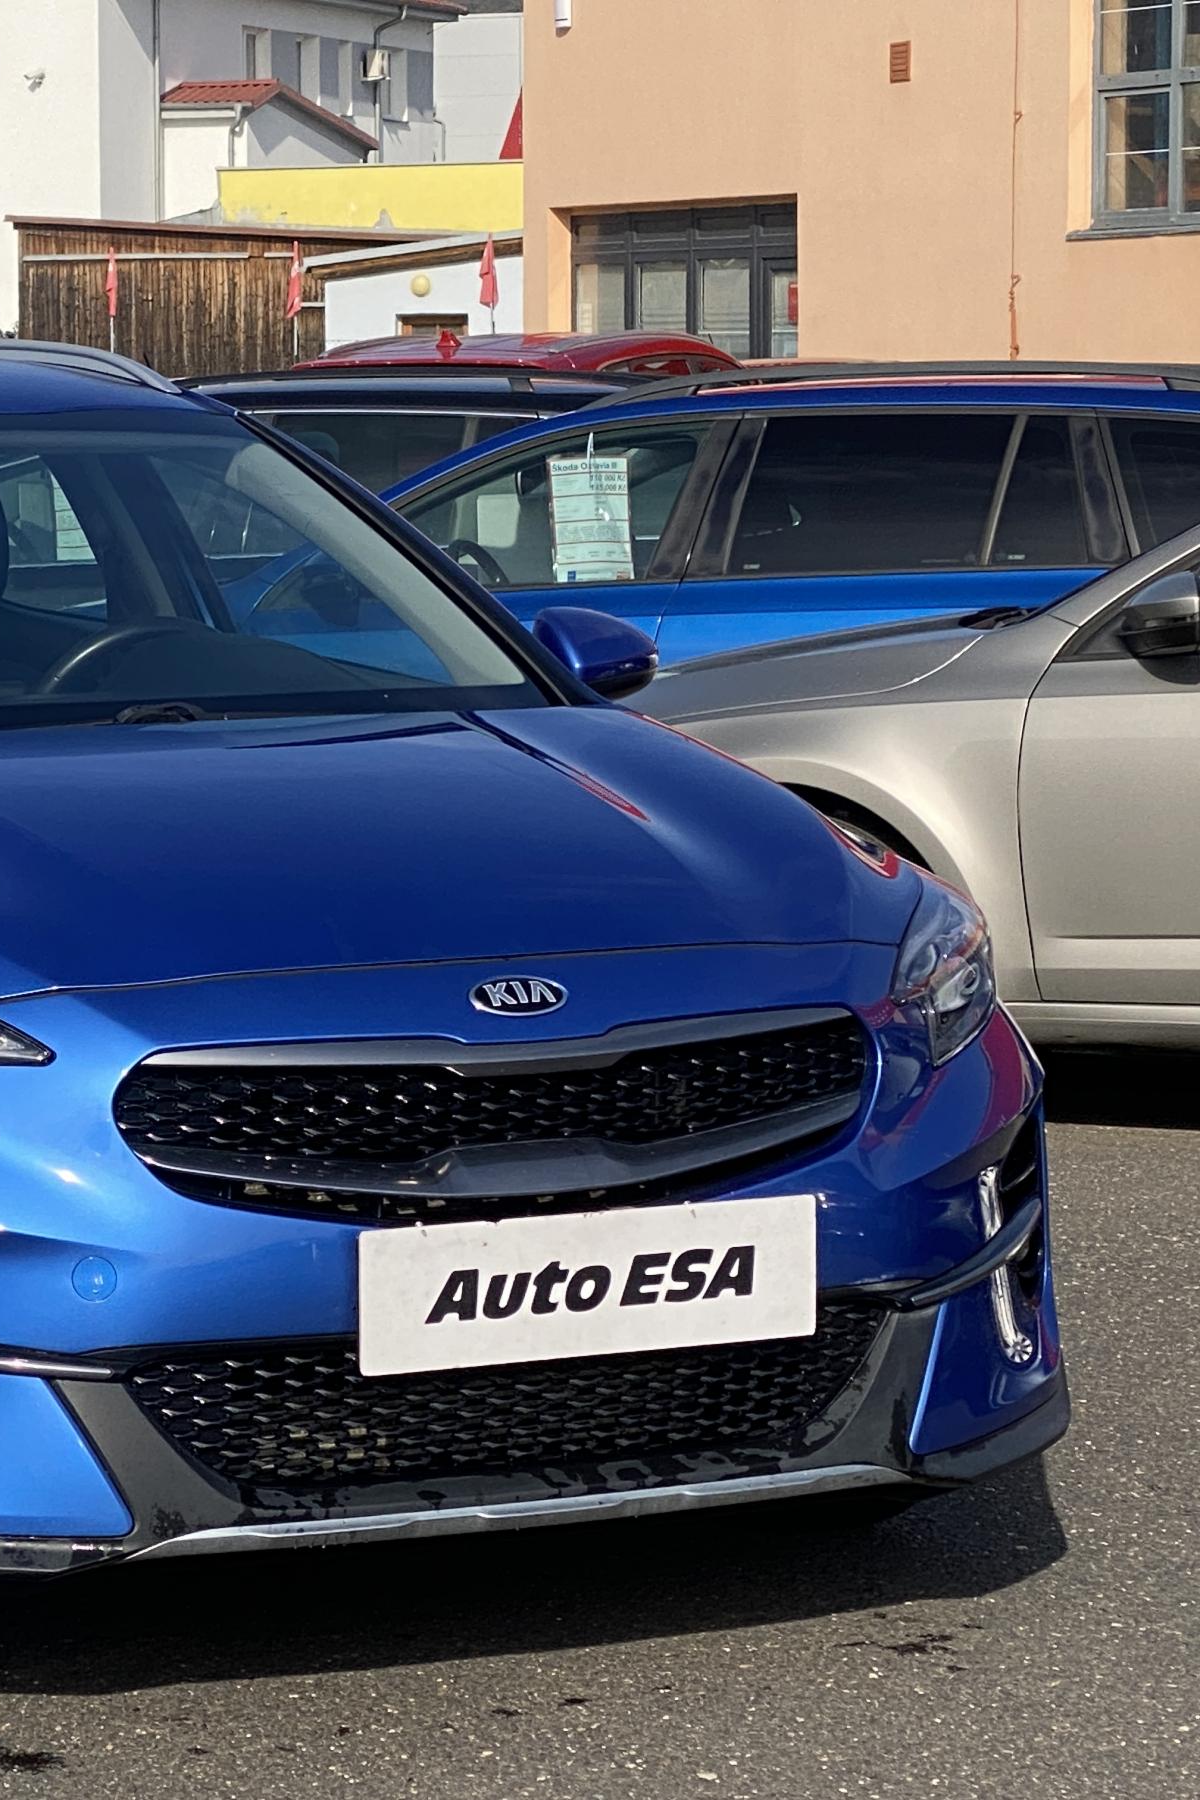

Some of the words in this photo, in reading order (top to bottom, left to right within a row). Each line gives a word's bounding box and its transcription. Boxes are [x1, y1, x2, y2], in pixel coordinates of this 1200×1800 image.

[580, 462, 610, 470] Otavia
[482, 980, 557, 1006] KIA
[424, 1260, 612, 1325] Auto
[618, 1245, 756, 1308] ESA
